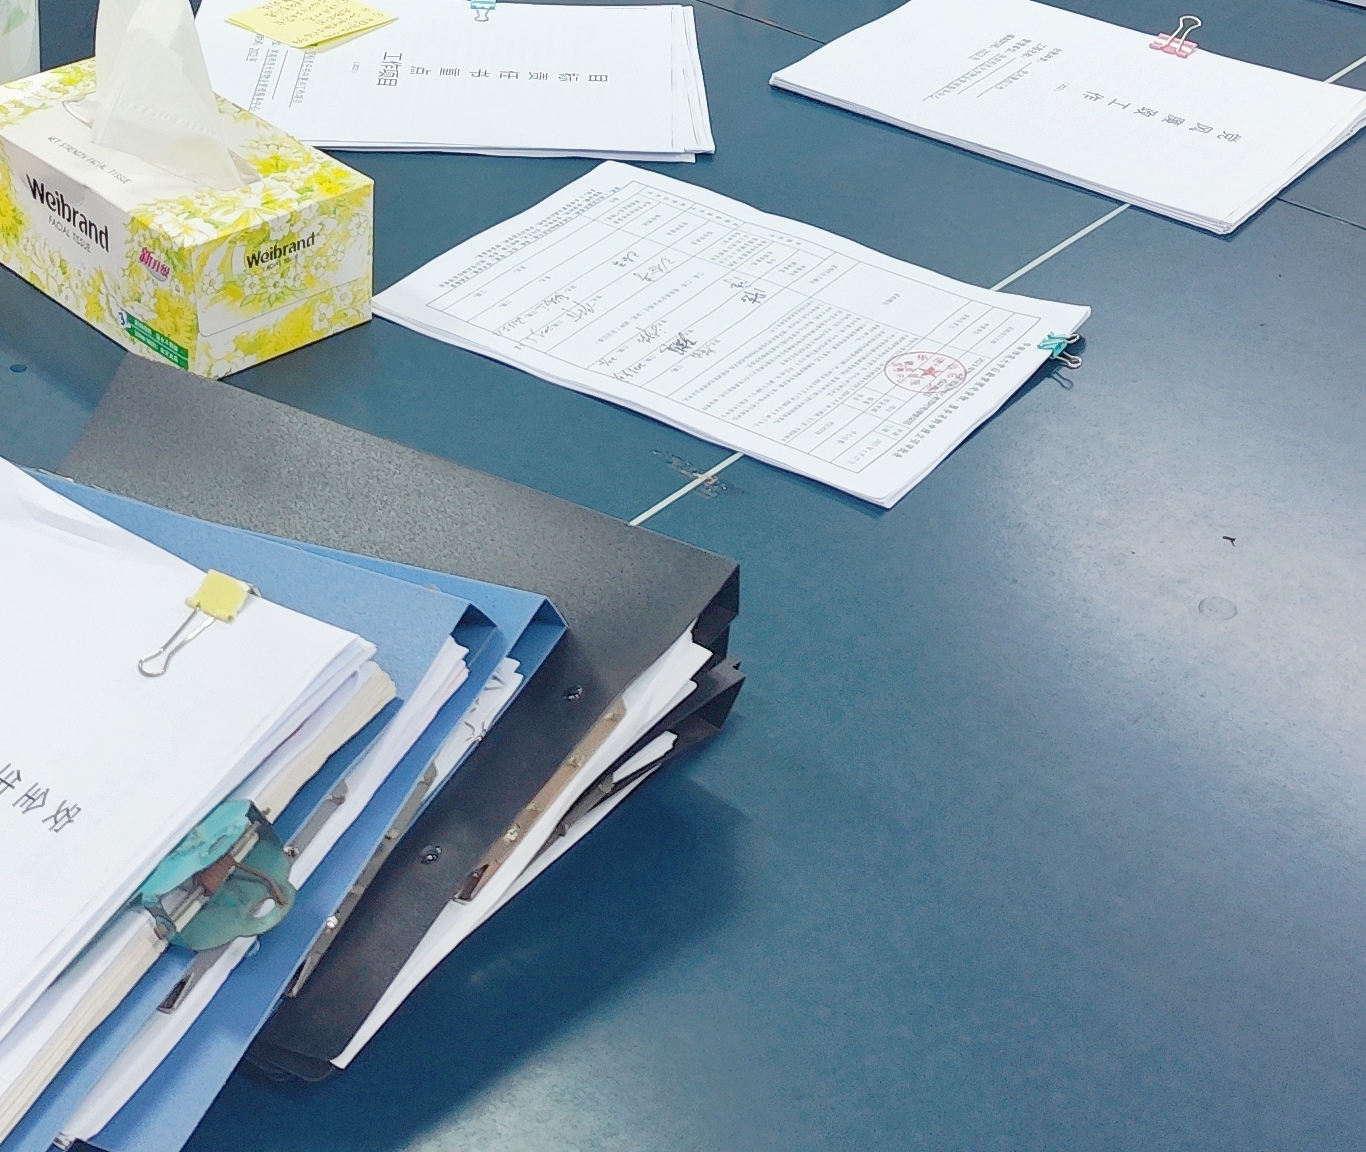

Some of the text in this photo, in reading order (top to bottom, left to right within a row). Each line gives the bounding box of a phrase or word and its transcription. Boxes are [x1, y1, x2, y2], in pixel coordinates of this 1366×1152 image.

[25, 173, 110, 253] Weibrand
[48, 215, 91, 253] FACIAL TISSUE
[246, 232, 315, 268] Weibrand
